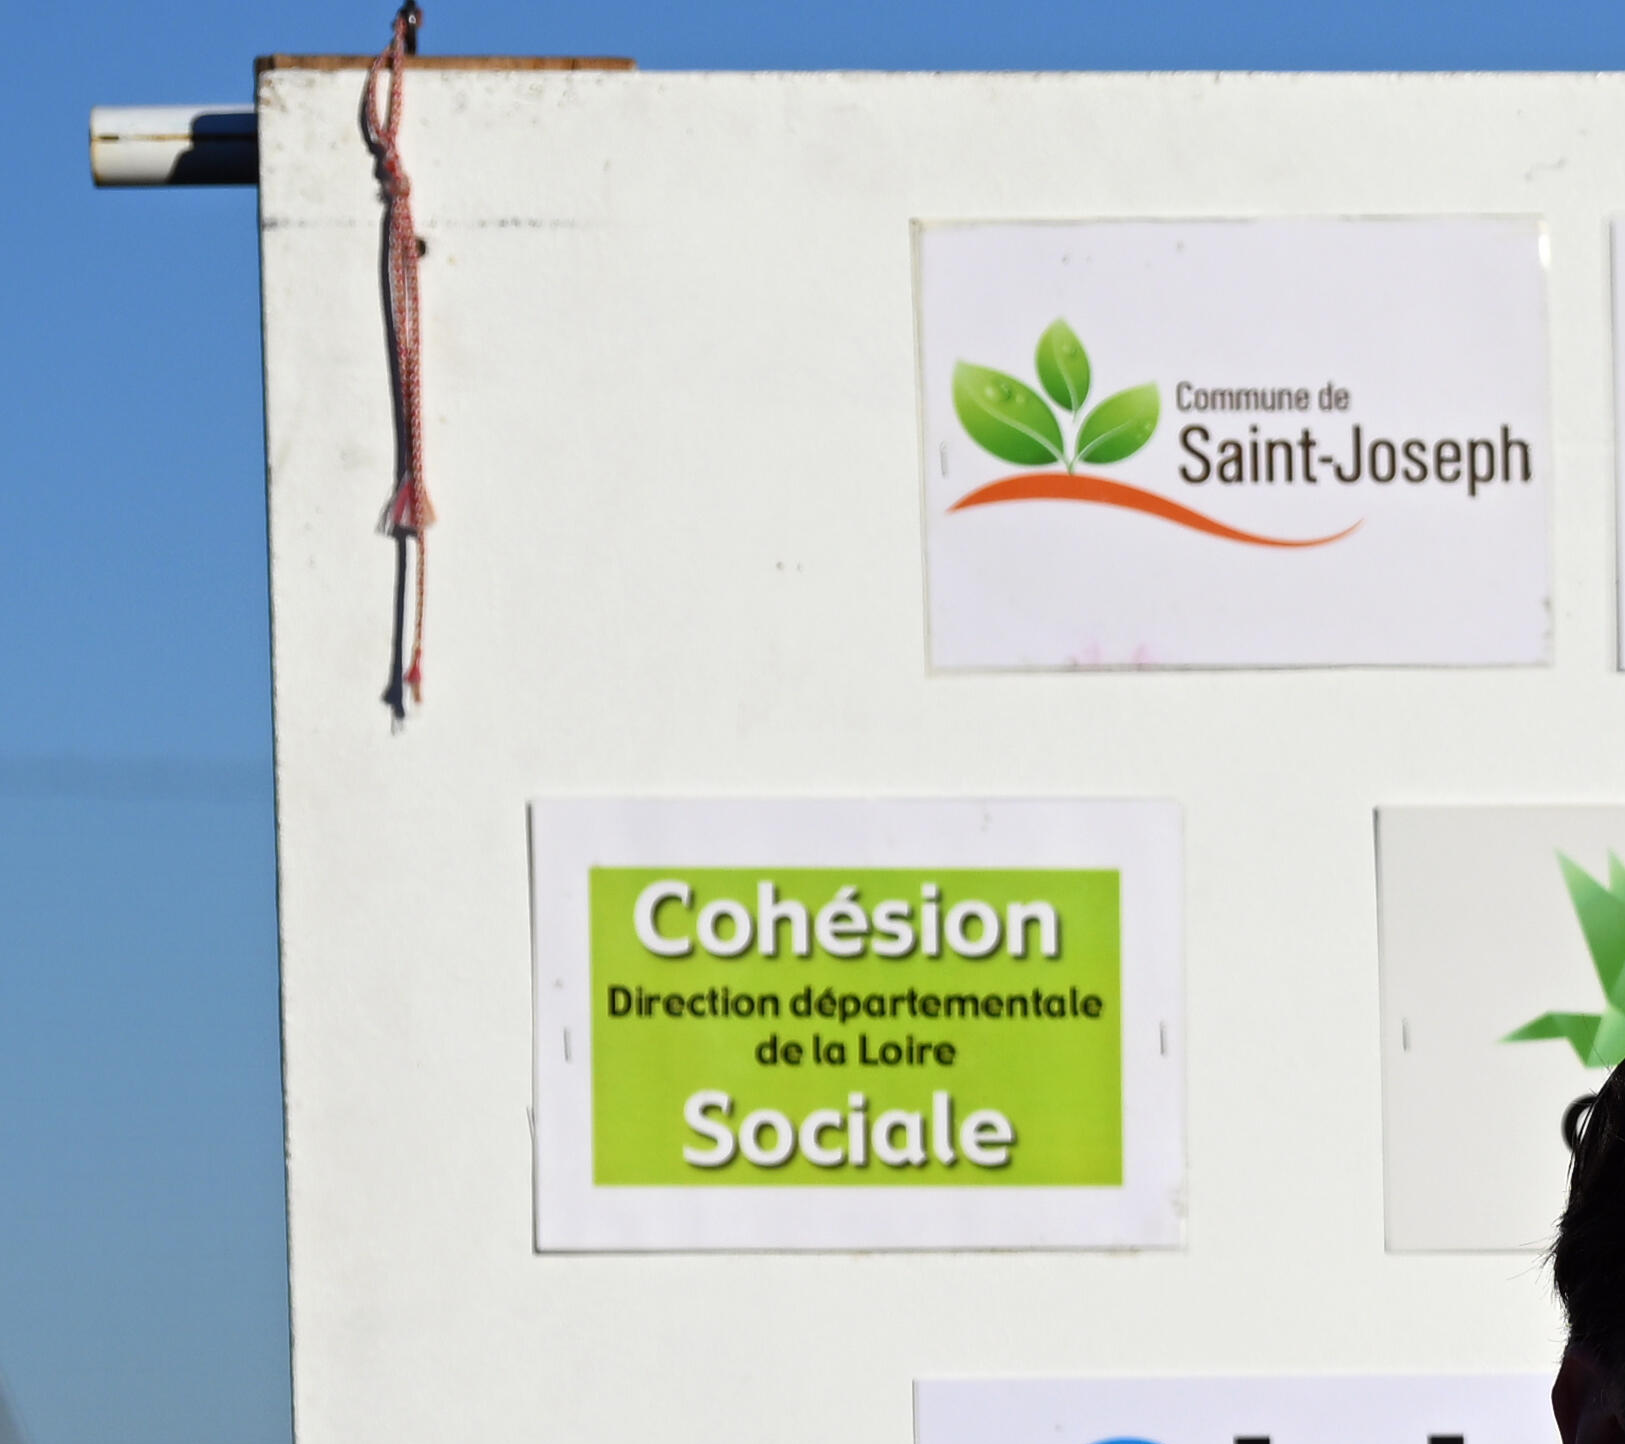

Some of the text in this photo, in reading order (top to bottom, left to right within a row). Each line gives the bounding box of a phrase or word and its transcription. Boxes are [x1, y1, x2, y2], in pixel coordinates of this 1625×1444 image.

[1176, 380, 1351, 414] Commune de
[1177, 422, 1533, 498] Saint-Joseph
[633, 877, 1063, 960] Cohésion
[606, 983, 1104, 1029] Direction départementale
[754, 1032, 958, 1069] de la Loire
[681, 1088, 1017, 1170] Sociale
